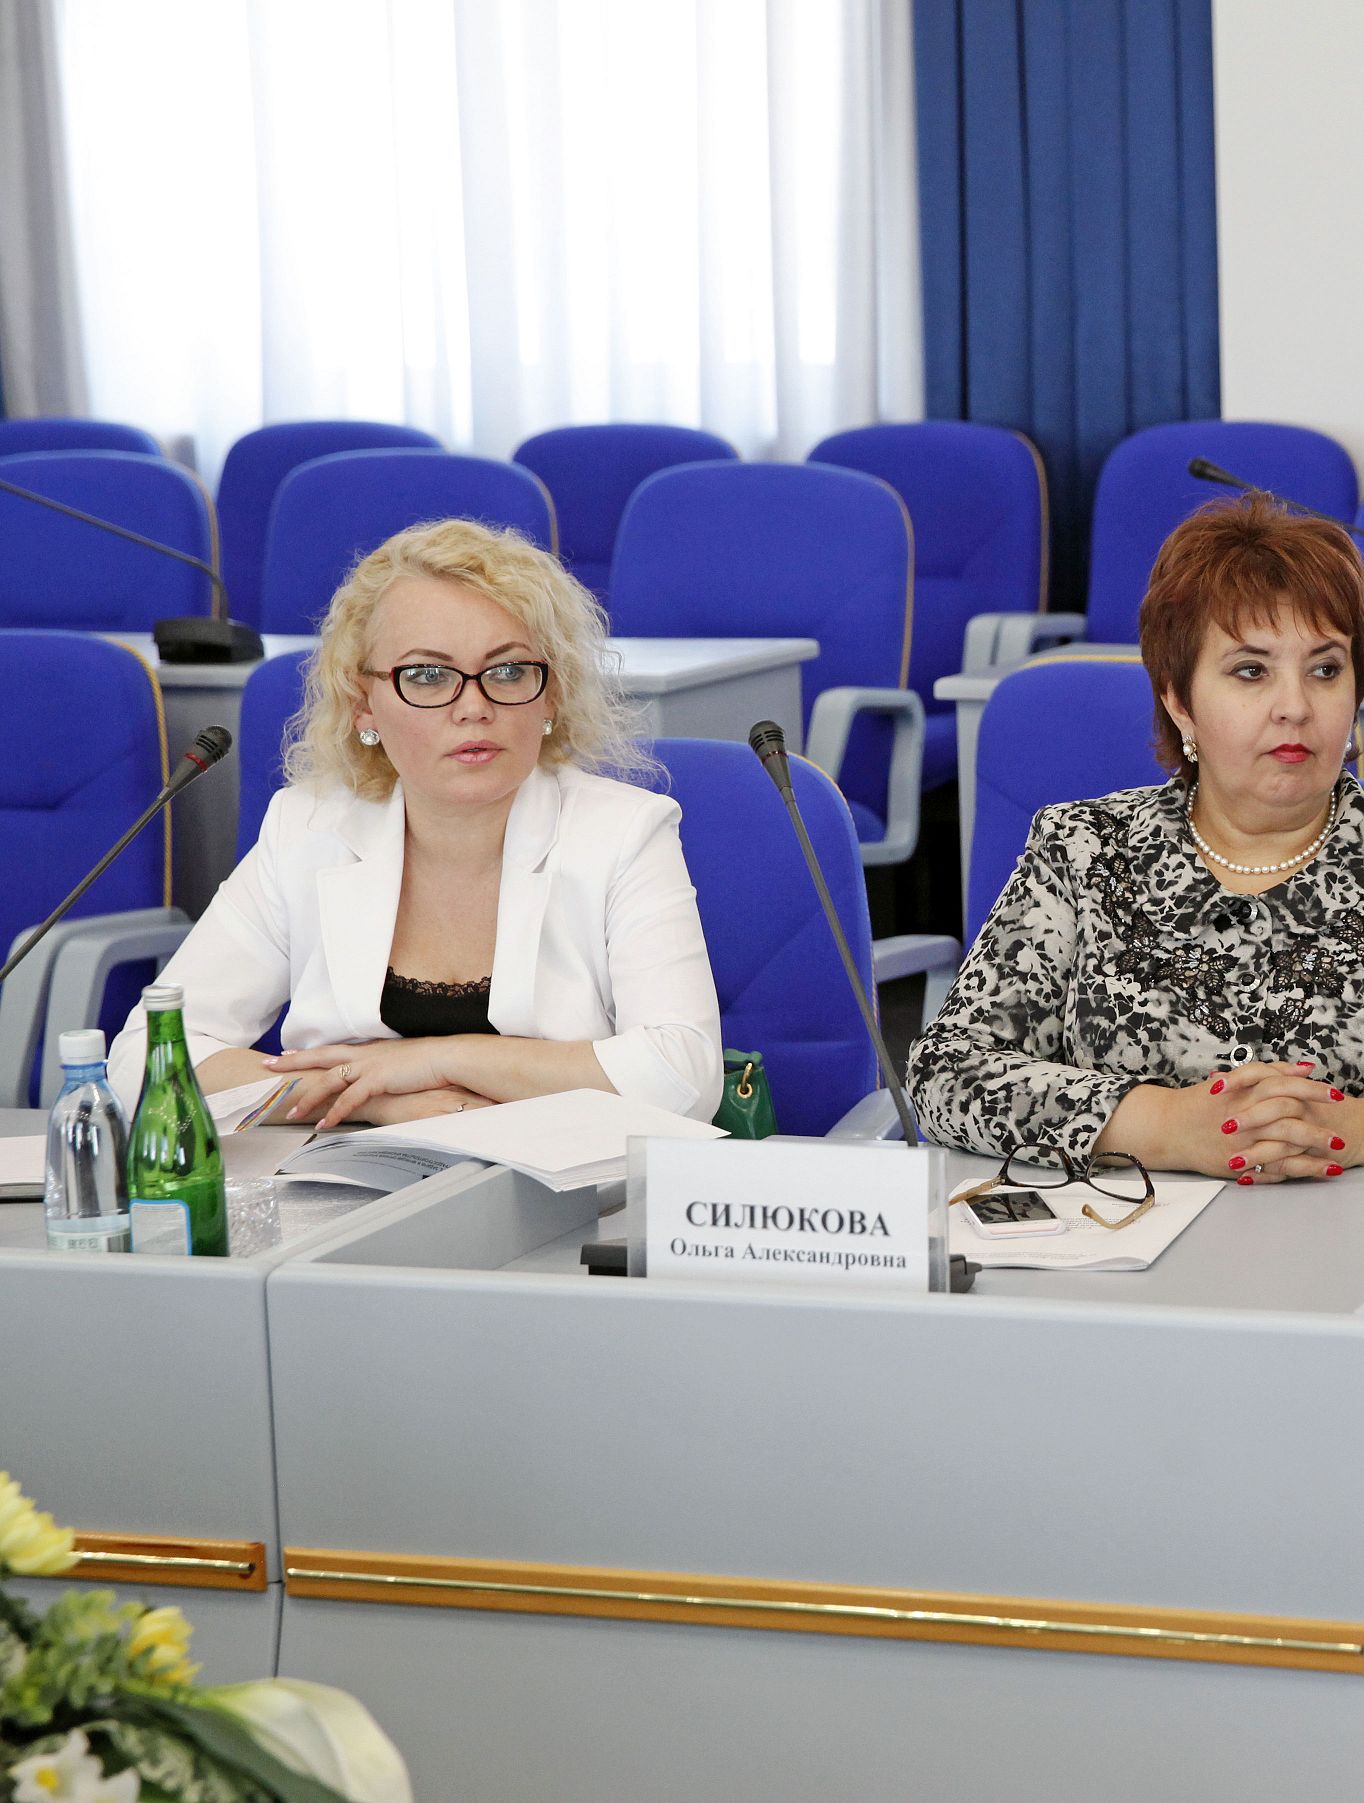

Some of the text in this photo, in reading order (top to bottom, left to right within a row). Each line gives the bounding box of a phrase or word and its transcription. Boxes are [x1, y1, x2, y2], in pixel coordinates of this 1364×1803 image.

[686, 1201, 890, 1237] СИЛЮКОВА
[670, 1238, 906, 1270] Ольга Александровна
